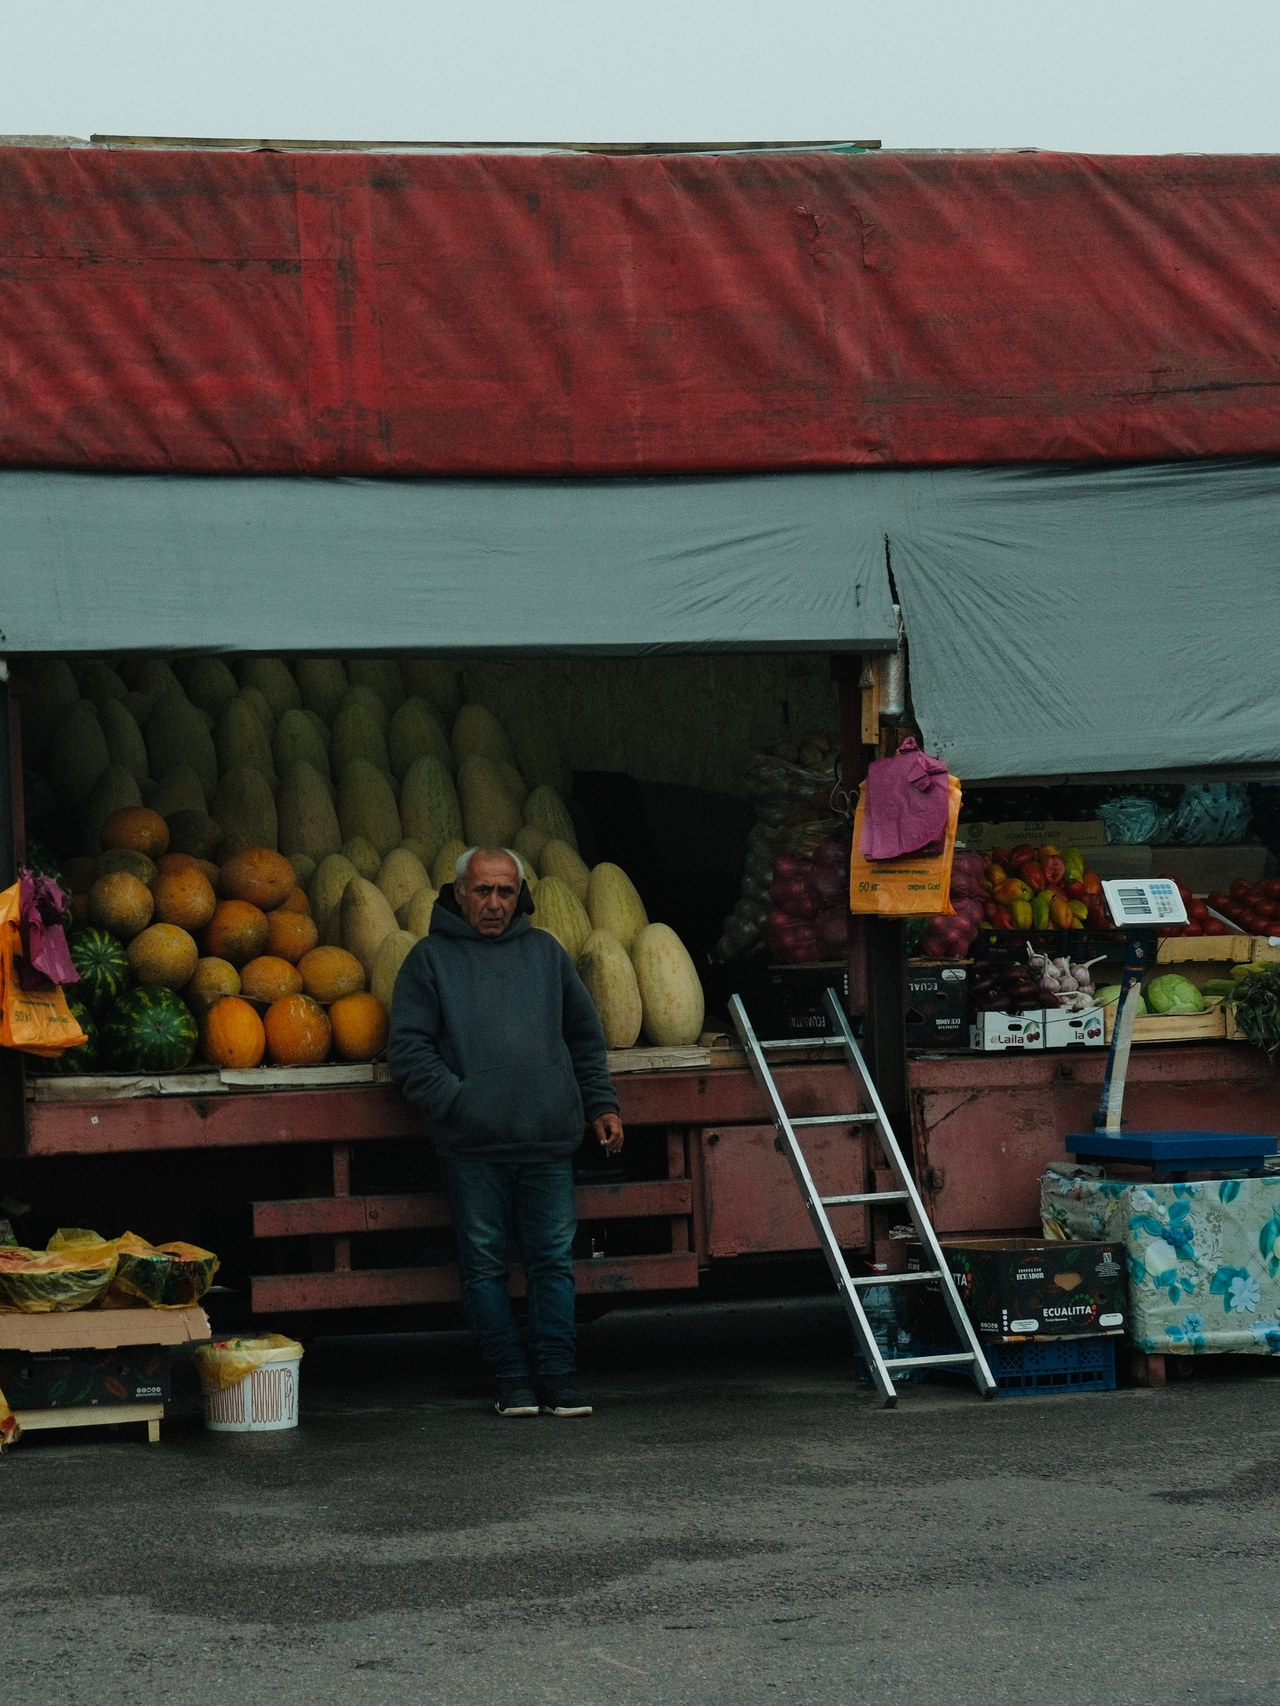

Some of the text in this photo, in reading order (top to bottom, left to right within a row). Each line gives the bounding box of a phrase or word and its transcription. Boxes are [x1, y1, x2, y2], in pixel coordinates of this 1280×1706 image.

[1005, 832, 1042, 840] DONATELLA
[858, 881, 870, 892] 50
[927, 882, 941, 891] Gold
[908, 983, 938, 991] ECUAL
[14, 1010, 24, 1021] 50
[997, 1034, 1024, 1044] Laila
[1016, 1272, 1045, 1280] ECUADOR
[1042, 1305, 1092, 1317] ECUALITTA
